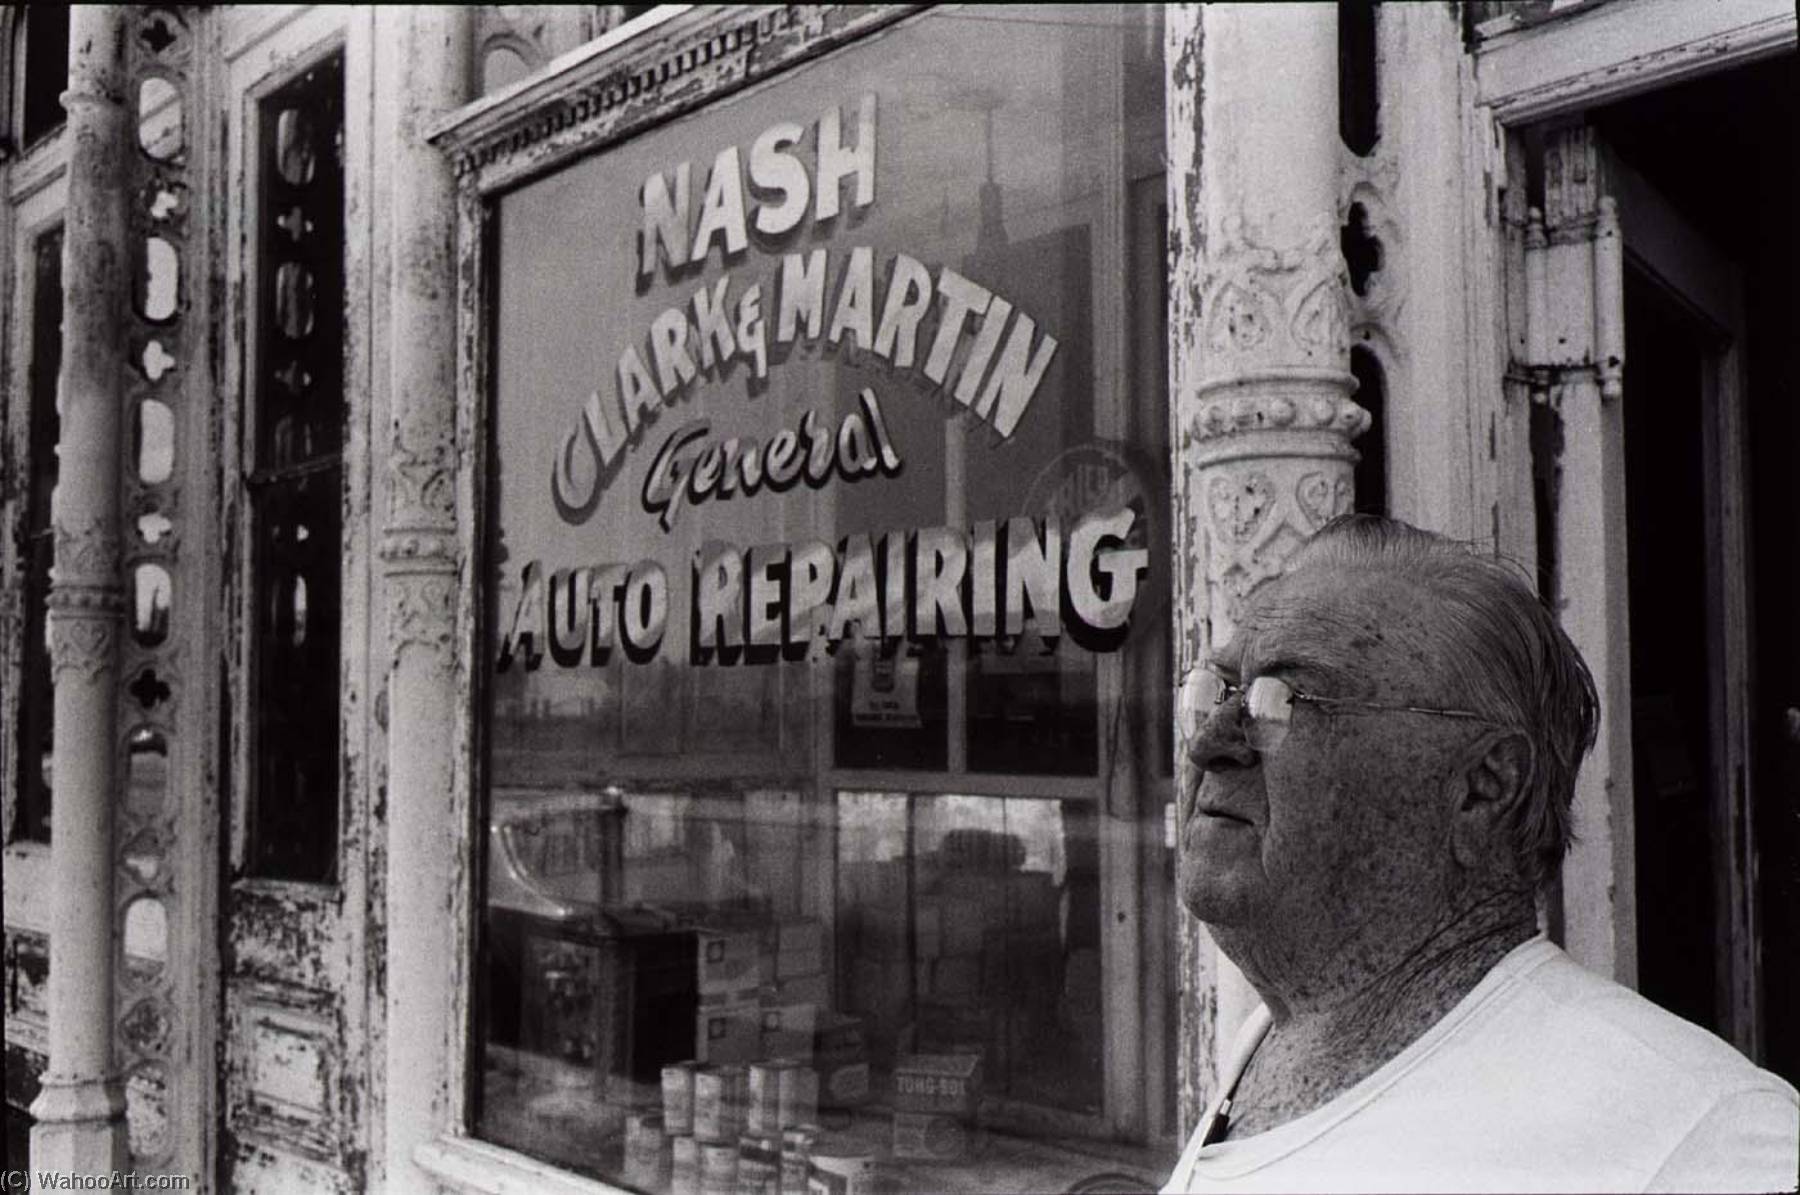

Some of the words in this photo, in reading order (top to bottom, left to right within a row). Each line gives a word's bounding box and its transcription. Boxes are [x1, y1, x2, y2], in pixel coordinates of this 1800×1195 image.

[637, 92, 877, 294] NASH
[776, 246, 1059, 440] MARTIN
[641, 387, 904, 533] General
[500, 559, 669, 668] AUTO
[690, 506, 1149, 666] REPAIRING
